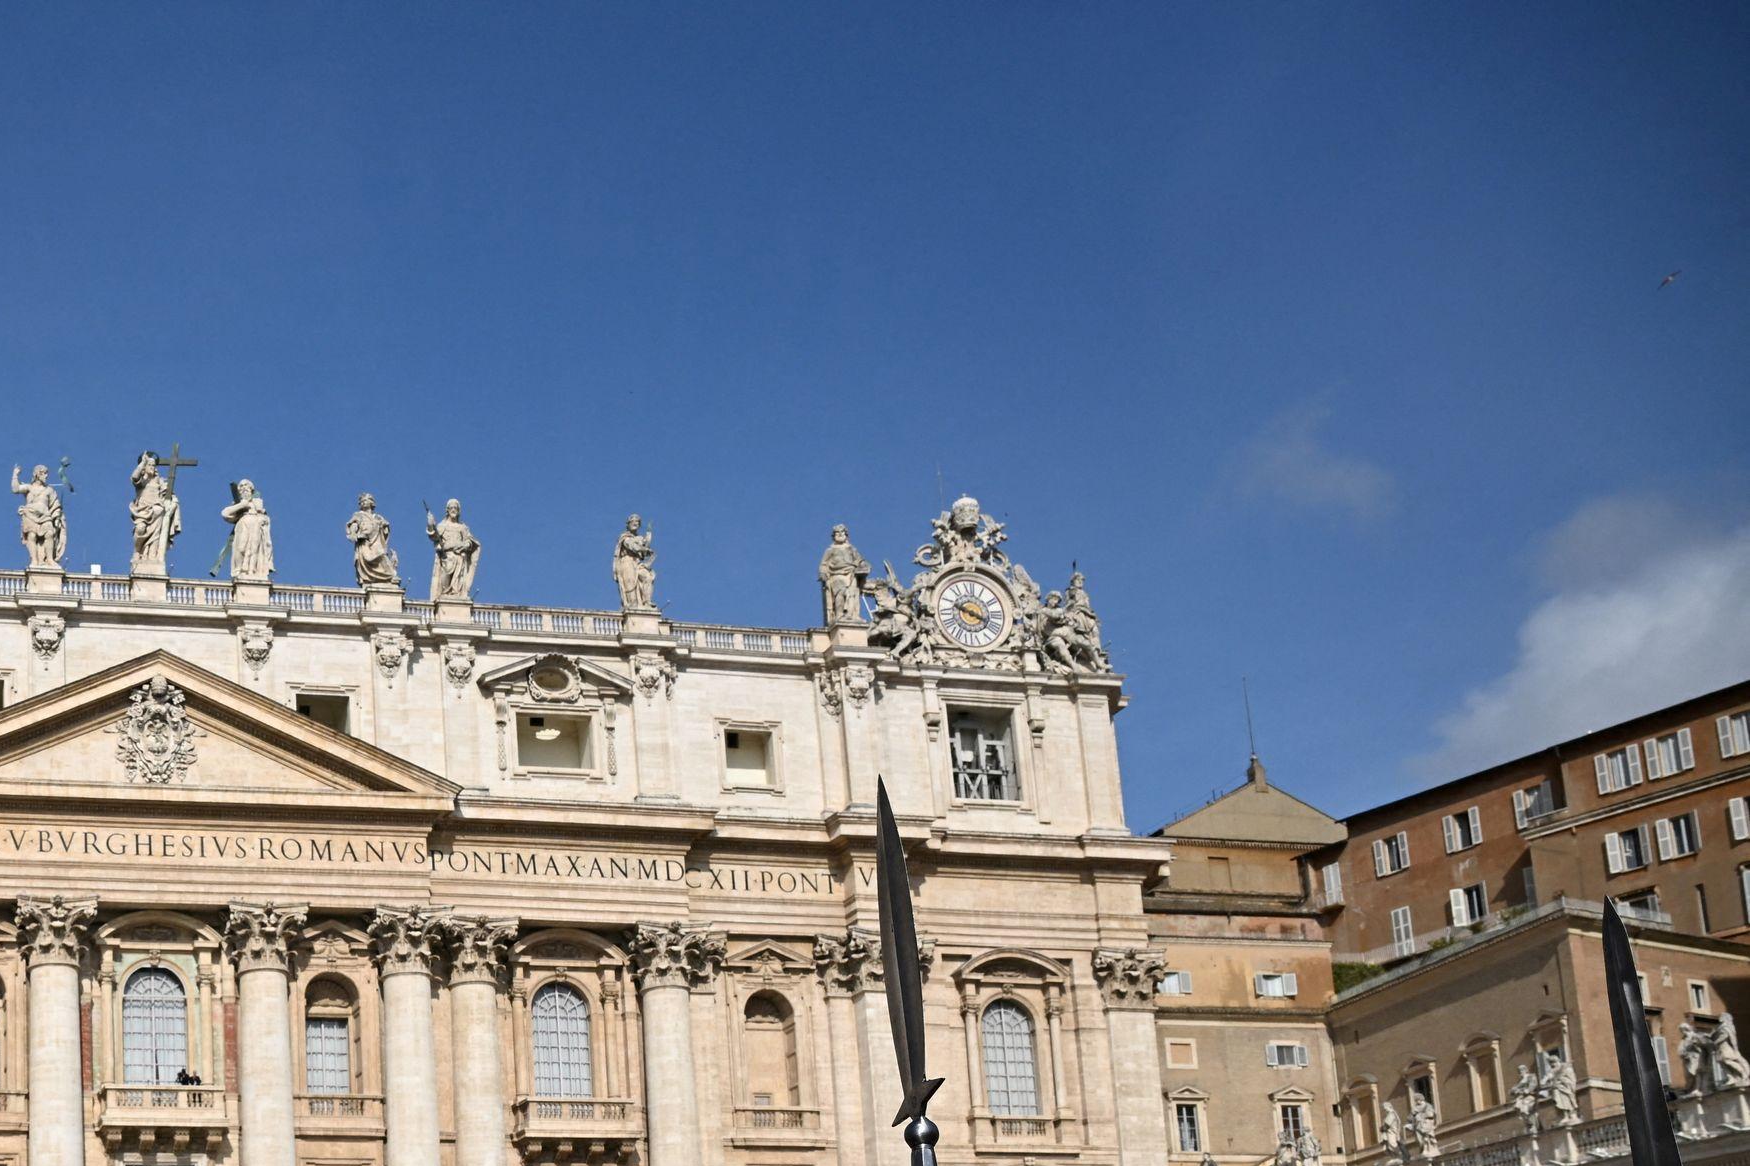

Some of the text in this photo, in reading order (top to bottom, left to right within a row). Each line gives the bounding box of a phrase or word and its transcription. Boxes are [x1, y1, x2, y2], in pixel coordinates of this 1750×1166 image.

[5, 828, 28, 851] V
[37, 829, 248, 859] BVRGHESIVS
[257, 837, 427, 865] ROMANVS
[430, 850, 512, 874] PONT
[515, 853, 584, 877] MAX
[588, 856, 630, 879] AN
[637, 857, 750, 891] MDCXII
[760, 869, 838, 895] PONT
